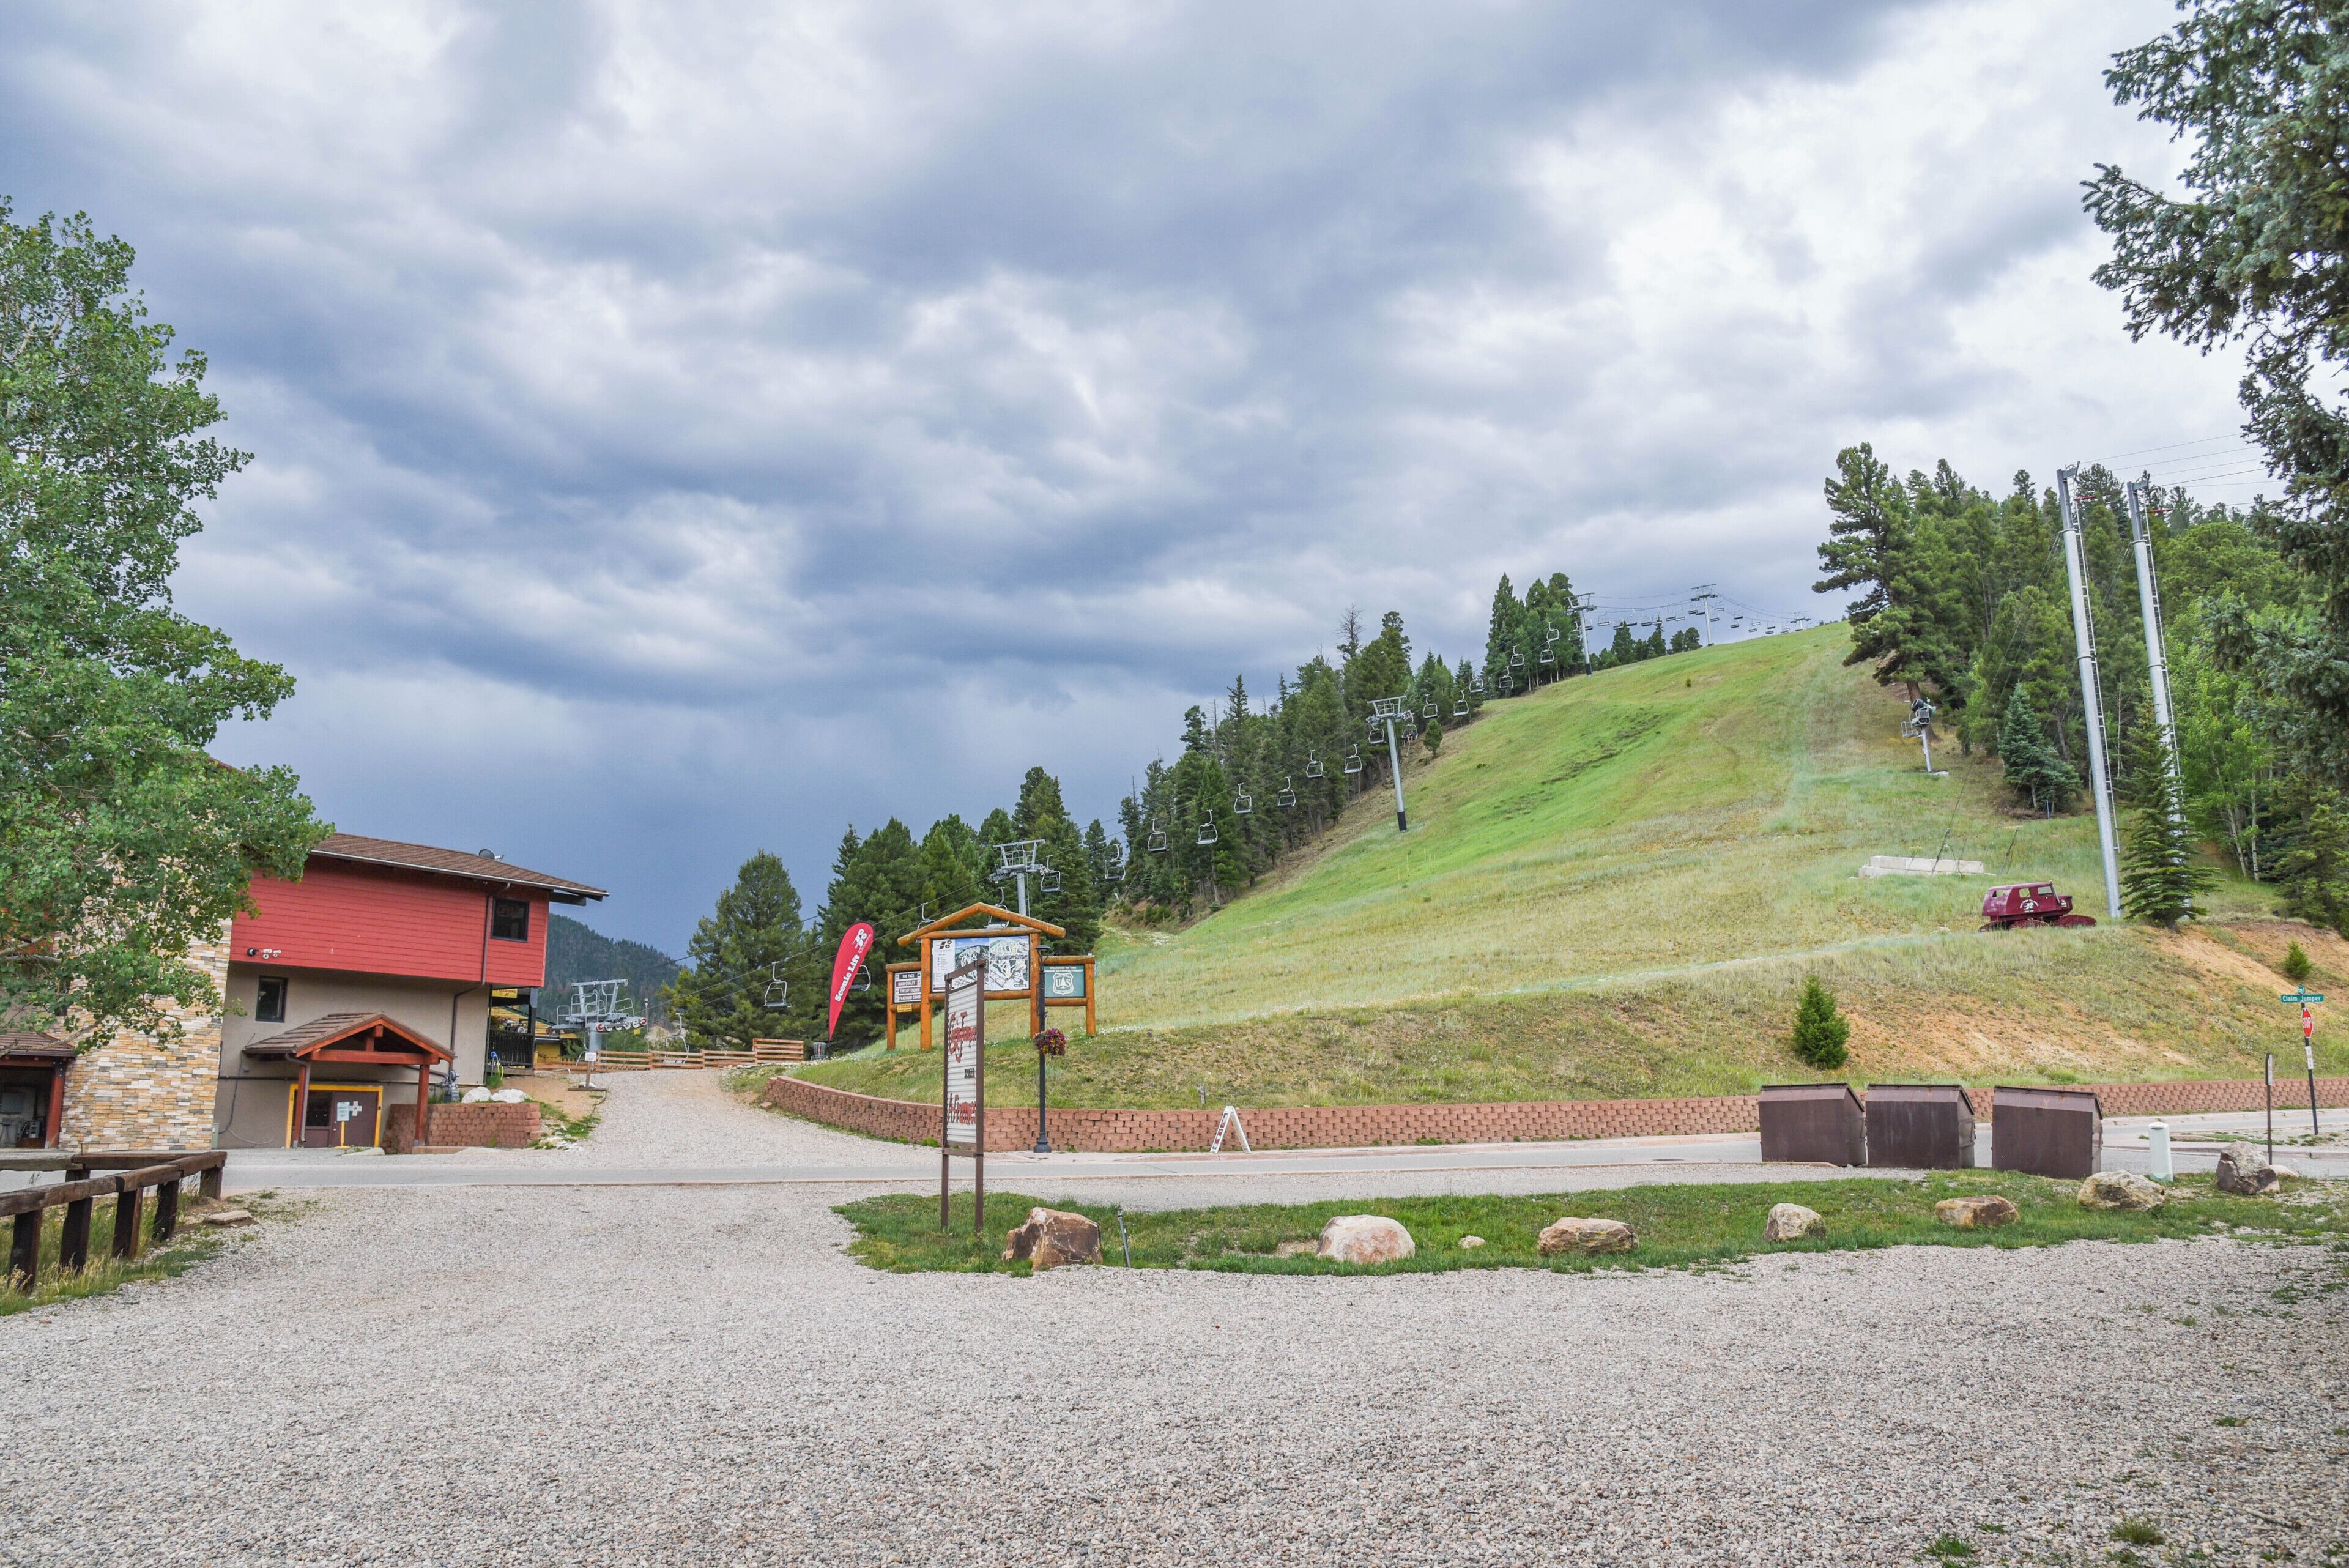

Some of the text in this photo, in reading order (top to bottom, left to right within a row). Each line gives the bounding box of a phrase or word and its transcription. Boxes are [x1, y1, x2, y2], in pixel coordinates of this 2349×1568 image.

[834, 954, 860, 1001] Scenic Lift
[2302, 1017, 2311, 1028] STOP
